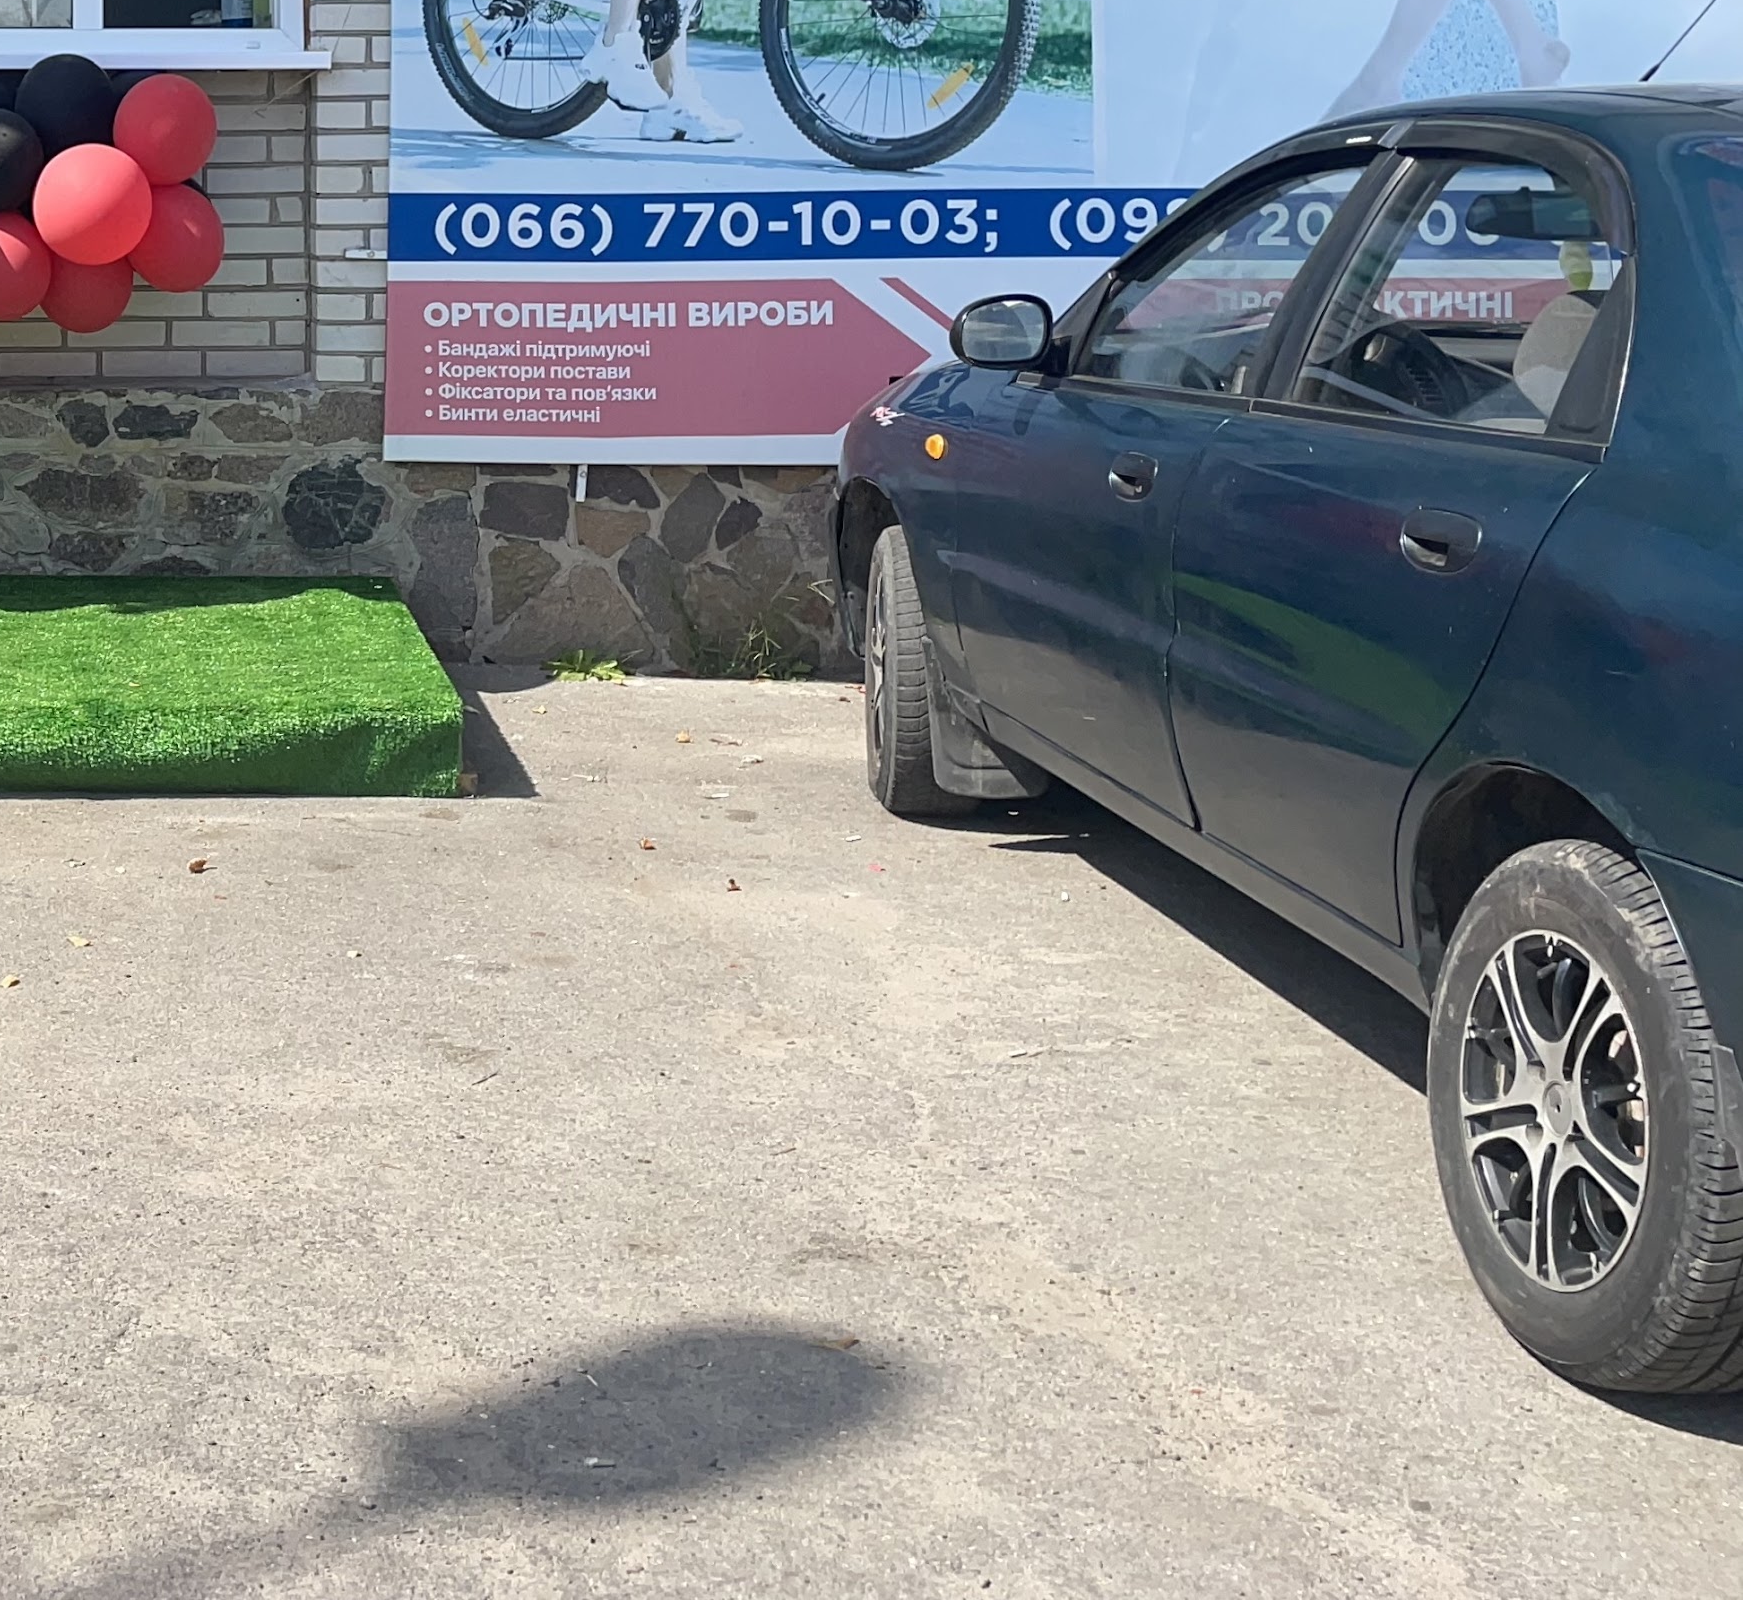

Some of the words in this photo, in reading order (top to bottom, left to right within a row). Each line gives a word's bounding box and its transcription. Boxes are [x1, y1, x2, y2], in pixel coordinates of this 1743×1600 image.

[433, 202, 614, 256] (066)
[642, 198, 1000, 253] 770-10-03;
[422, 301, 677, 333] ОРТОПЕДИЧНІ
[687, 299, 835, 327] ВИРОБИ
[438, 340, 521, 360] Бандажі
[525, 340, 651, 360] підтримуючі
[438, 363, 546, 382] Коректори
[549, 366, 631, 380] постави
[438, 383, 541, 403] Фіксатори
[546, 387, 567, 400] та
[438, 405, 498, 423] Бинти
[502, 405, 601, 423] еластичні
